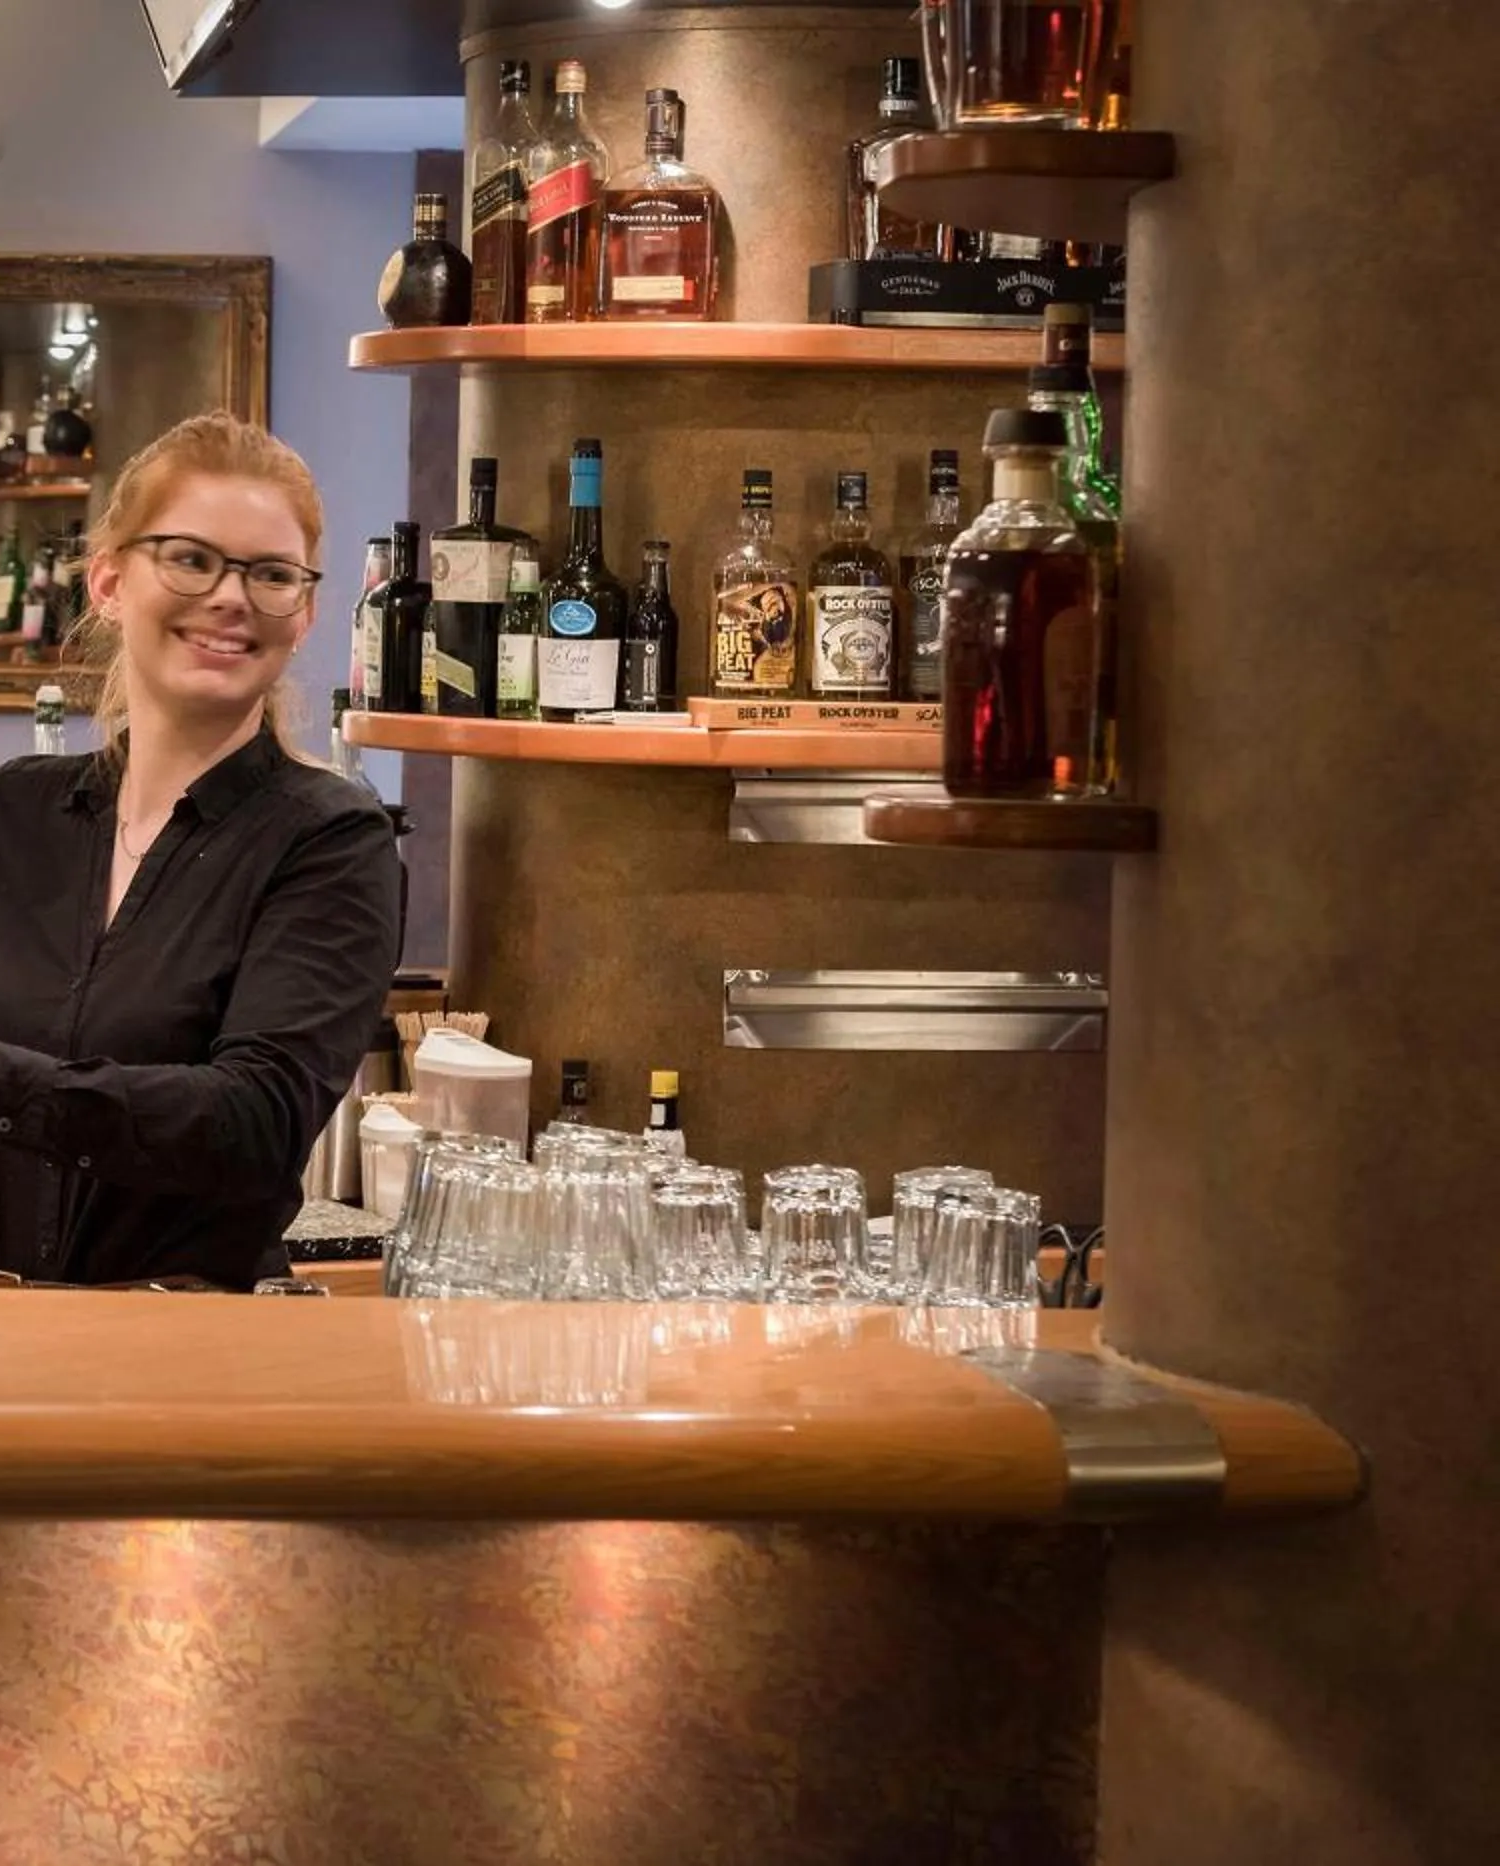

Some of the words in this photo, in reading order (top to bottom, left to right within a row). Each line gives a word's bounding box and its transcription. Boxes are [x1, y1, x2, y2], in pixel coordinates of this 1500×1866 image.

[825, 599, 856, 610] ROCK
[717, 632, 752, 653] BIG
[717, 654, 755, 671] PEAT
[737, 708, 757, 720] BIG
[761, 707, 791, 719] PEAT
[819, 707, 851, 719] ROCK
[852, 707, 899, 719] OYSTER
[915, 707, 941, 721] SCA
